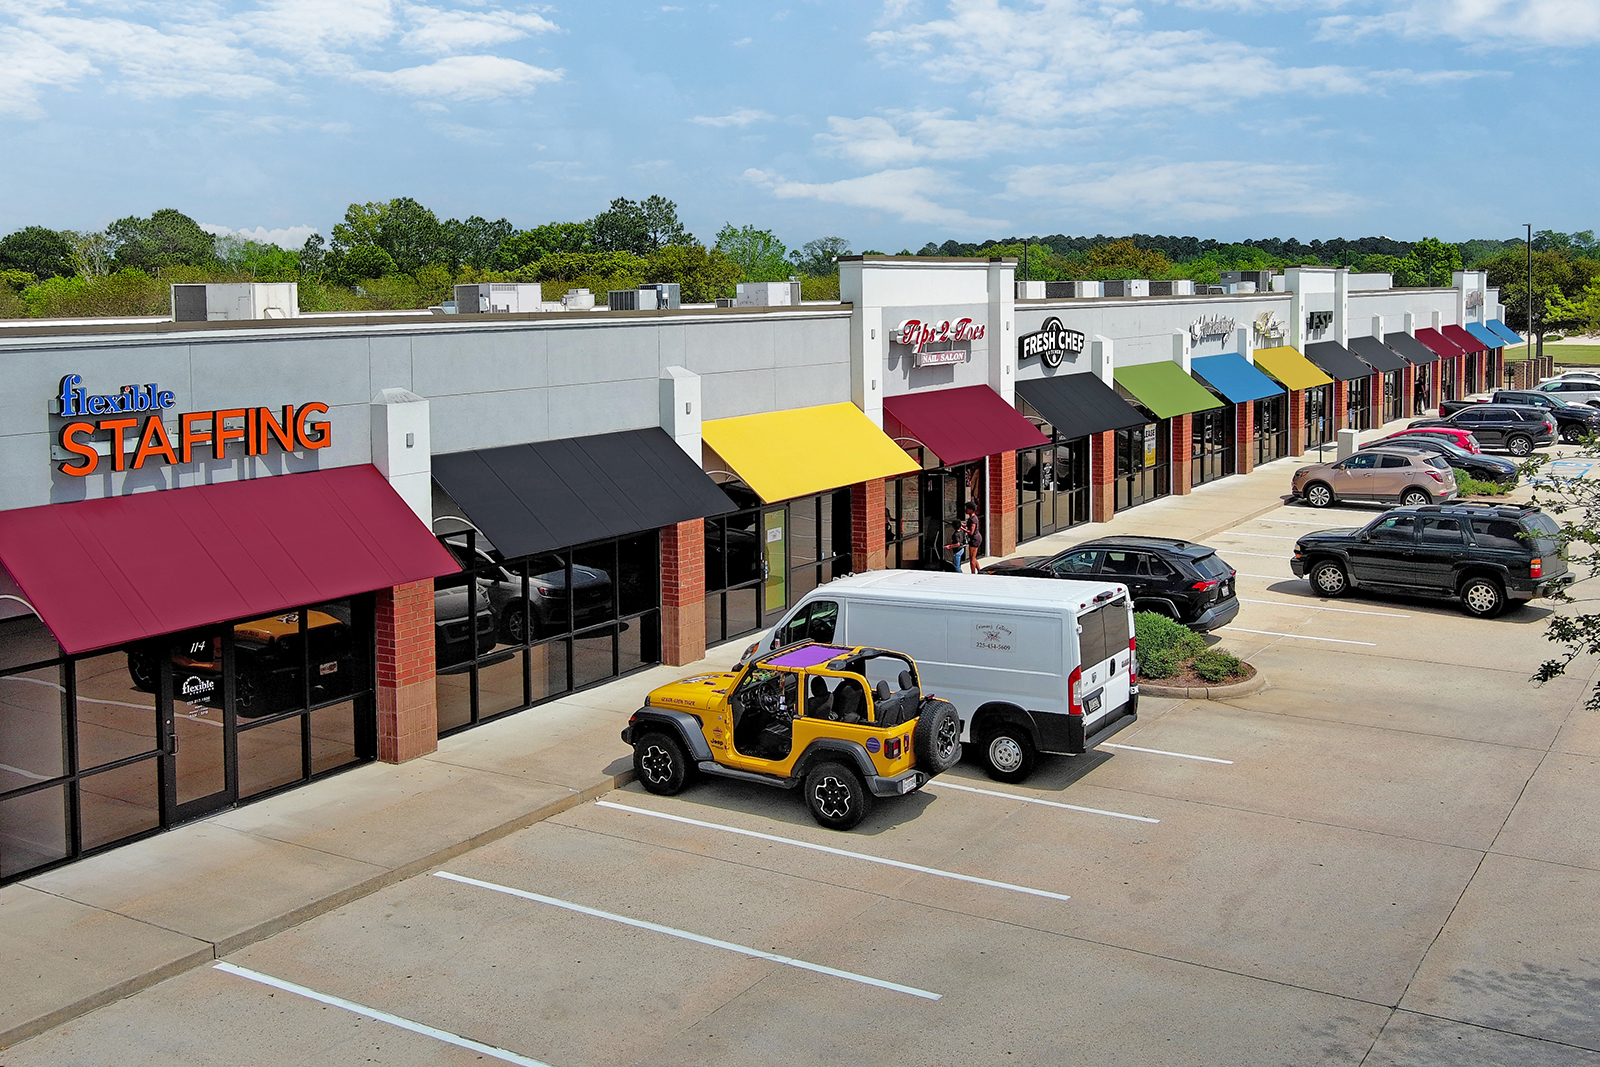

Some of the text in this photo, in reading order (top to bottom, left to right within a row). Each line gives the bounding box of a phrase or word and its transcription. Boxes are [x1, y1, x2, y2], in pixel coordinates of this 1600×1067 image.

[902, 317, 985, 353] Tips 2 Toes
[1023, 331, 1084, 358] FRESH CHEF
[922, 352, 964, 363] NAIL SALON
[60, 374, 175, 416] flexible
[60, 402, 331, 477] STAFFING
[190, 641, 206, 653] 114
[182, 679, 214, 694] flexible
[710, 738, 724, 746] Jeep
